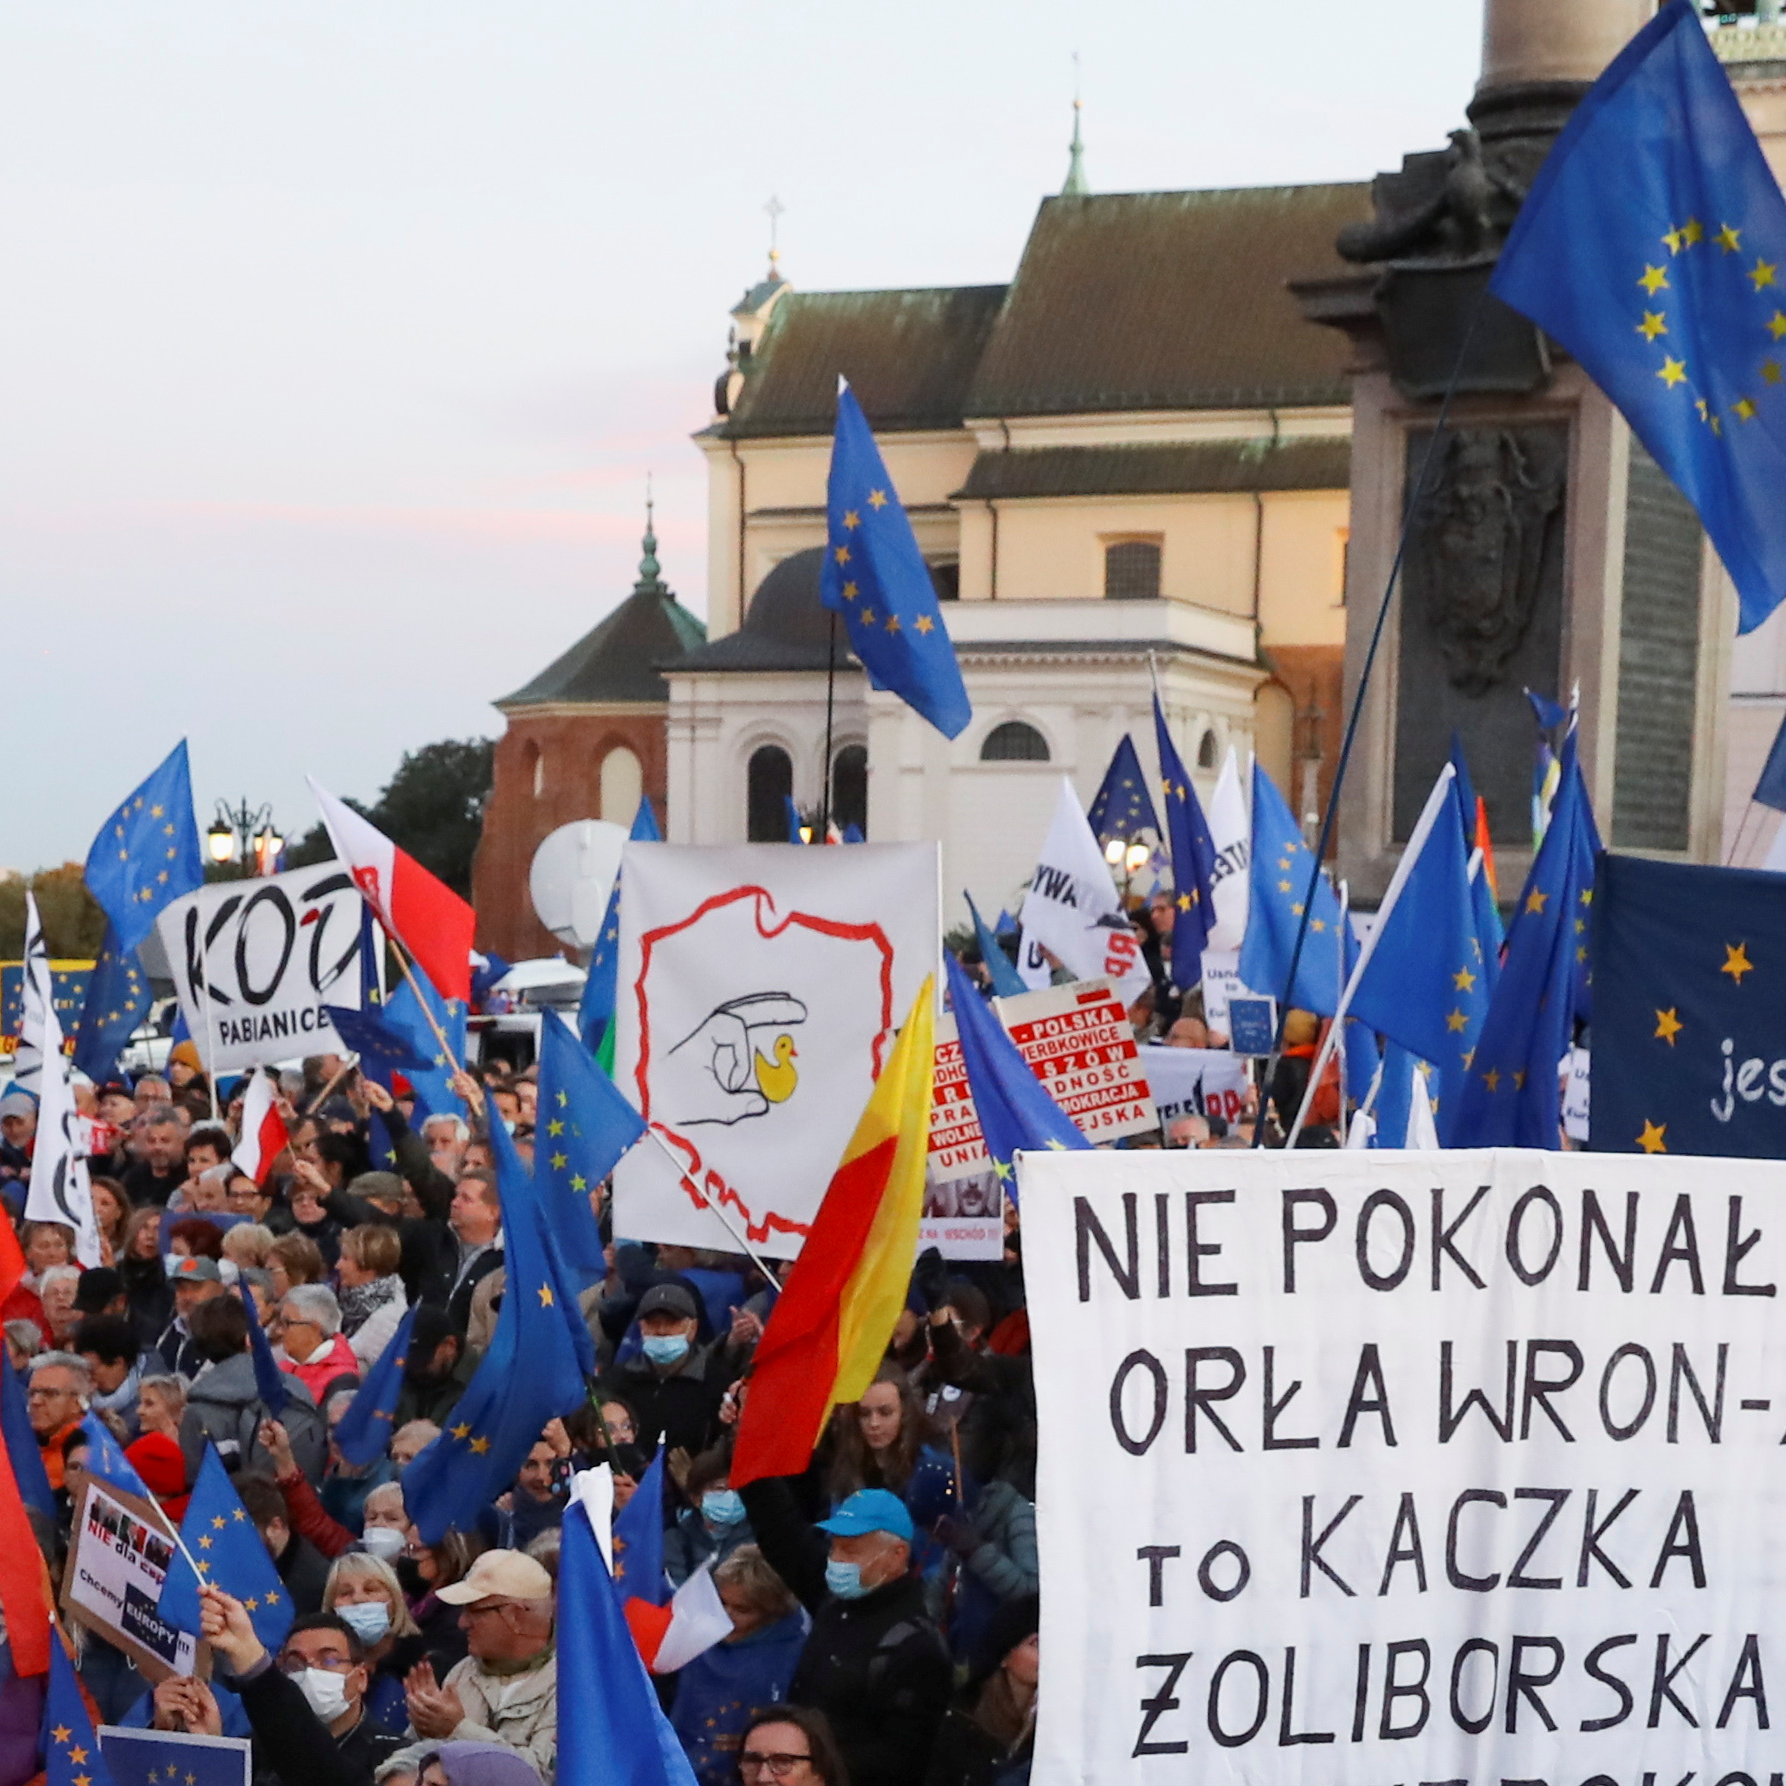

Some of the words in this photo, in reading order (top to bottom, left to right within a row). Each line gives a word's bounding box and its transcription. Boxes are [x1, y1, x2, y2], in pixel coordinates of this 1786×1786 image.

[186, 873, 362, 1012] KOD
[219, 1006, 330, 1046] PABIANICE
[1032, 1008, 1116, 1041] POLSKA
[1059, 1083, 1140, 1116] MOKRACJA
[1073, 1189, 1238, 1303] NIE
[1109, 1344, 1398, 1457] ORŁA
[87, 1519, 113, 1547] NIE
[115, 1540, 137, 1565] dla
[1137, 1539, 1251, 1607] TO
[1300, 1487, 1707, 1599] KACZKA
[80, 1568, 124, 1610] Chcemy
[125, 1603, 177, 1645] EUROPY
